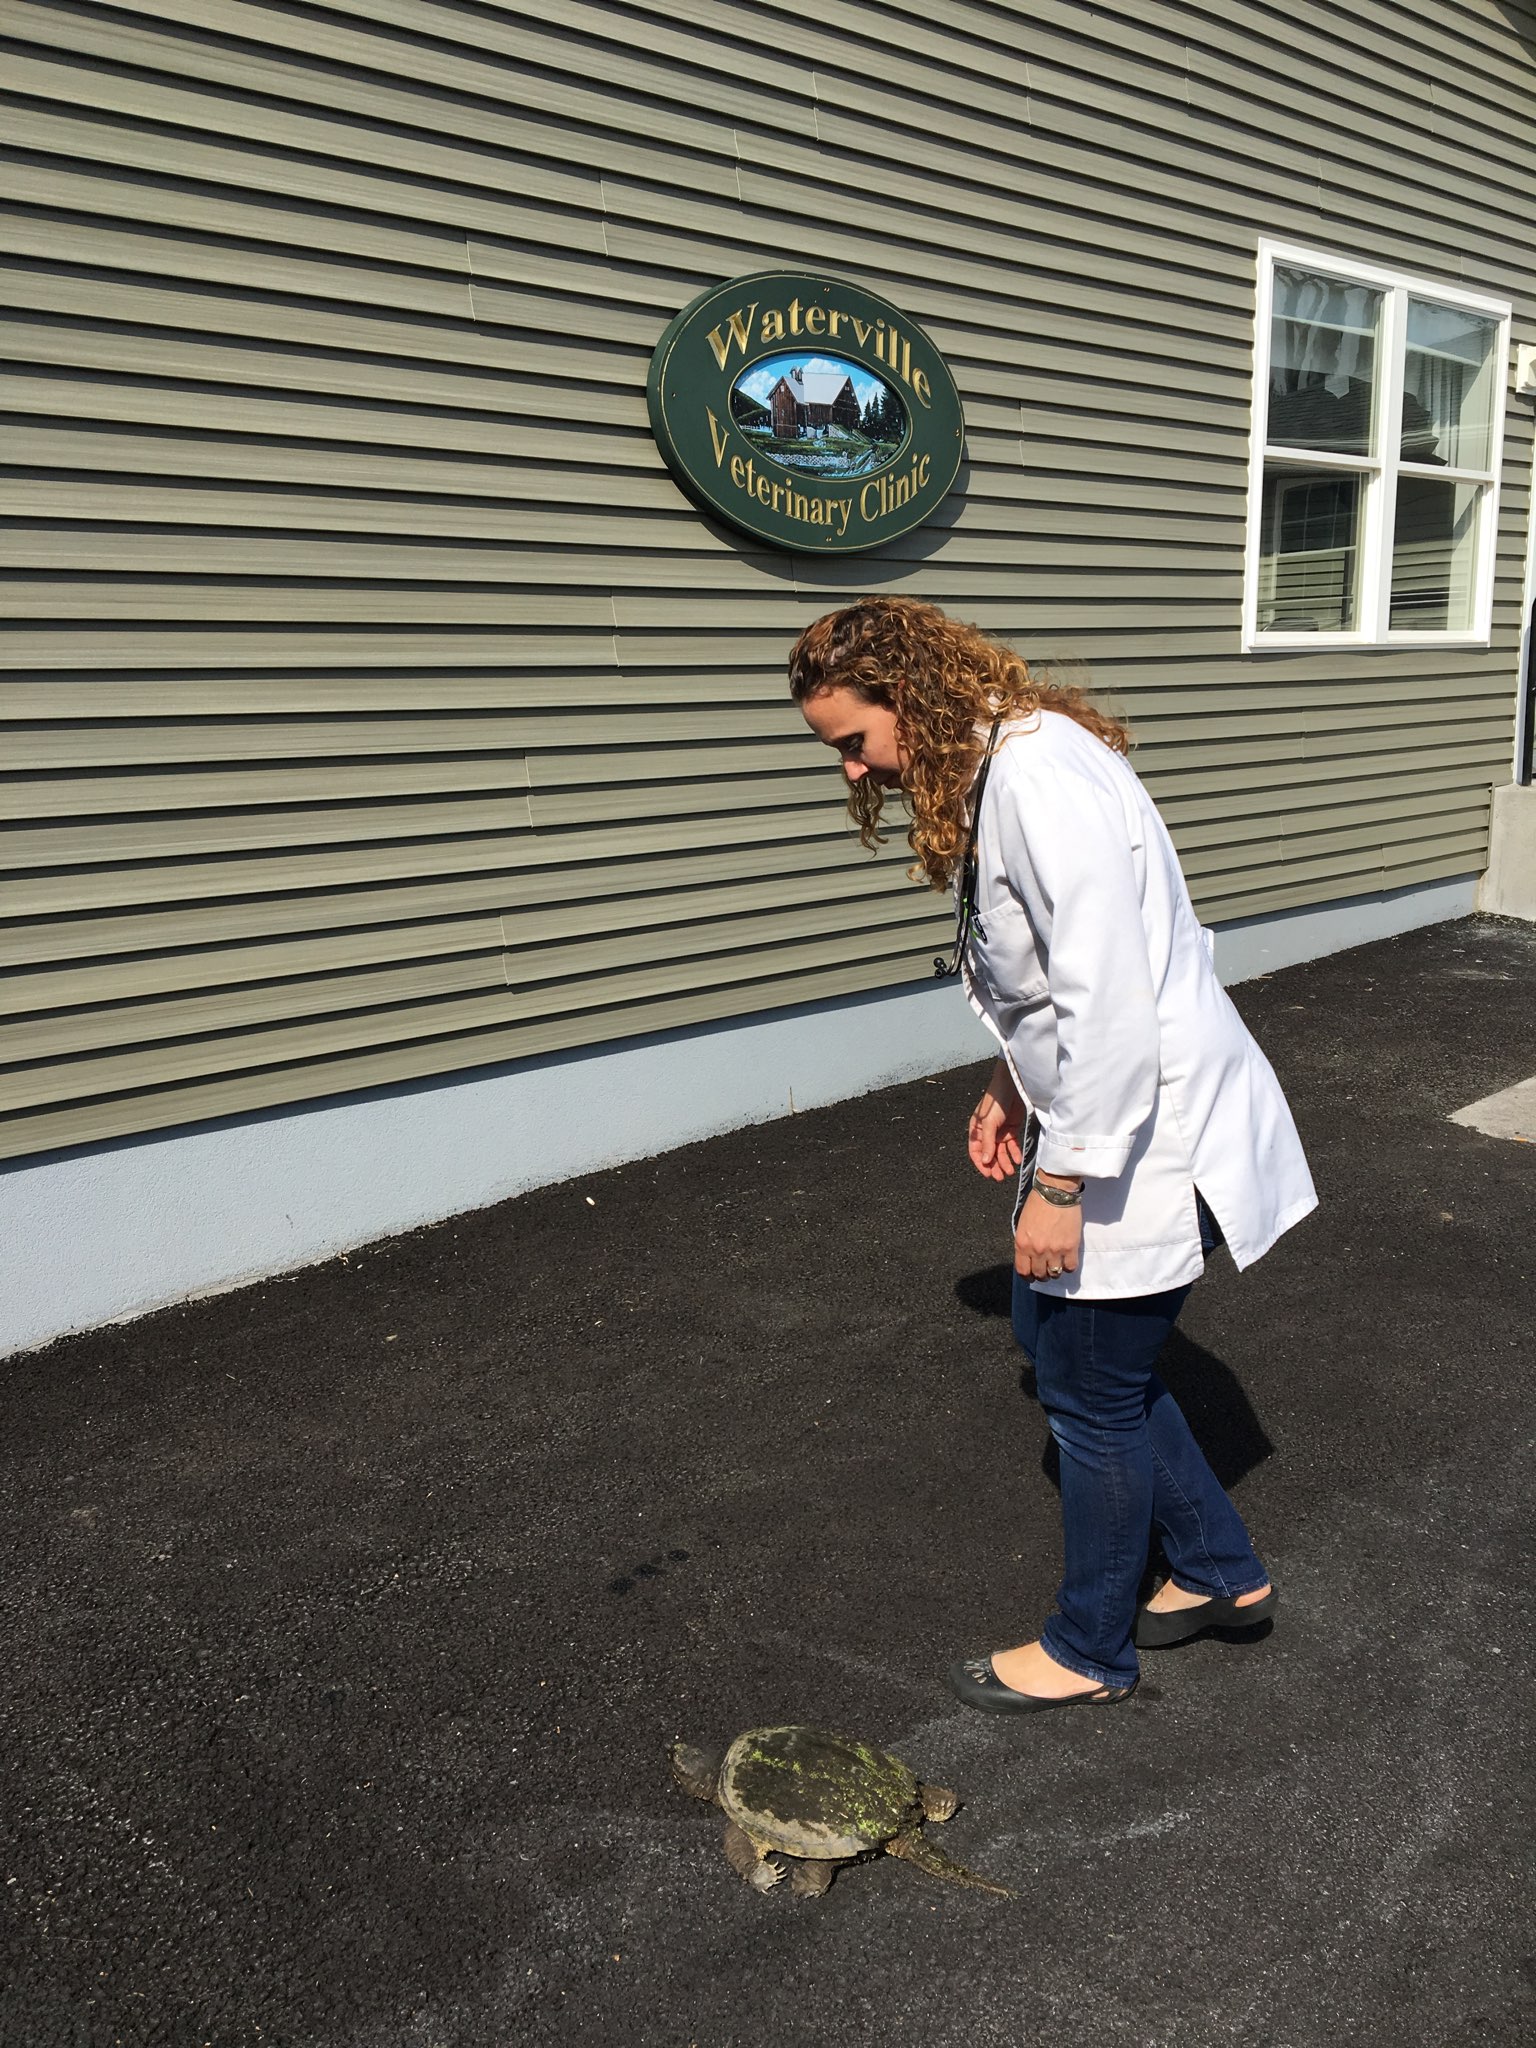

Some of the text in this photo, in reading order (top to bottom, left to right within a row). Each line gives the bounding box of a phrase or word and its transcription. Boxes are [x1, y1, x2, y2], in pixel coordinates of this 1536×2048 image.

[705, 298, 931, 409] Waterville
[705, 406, 931, 536] Veterinary Clinic
